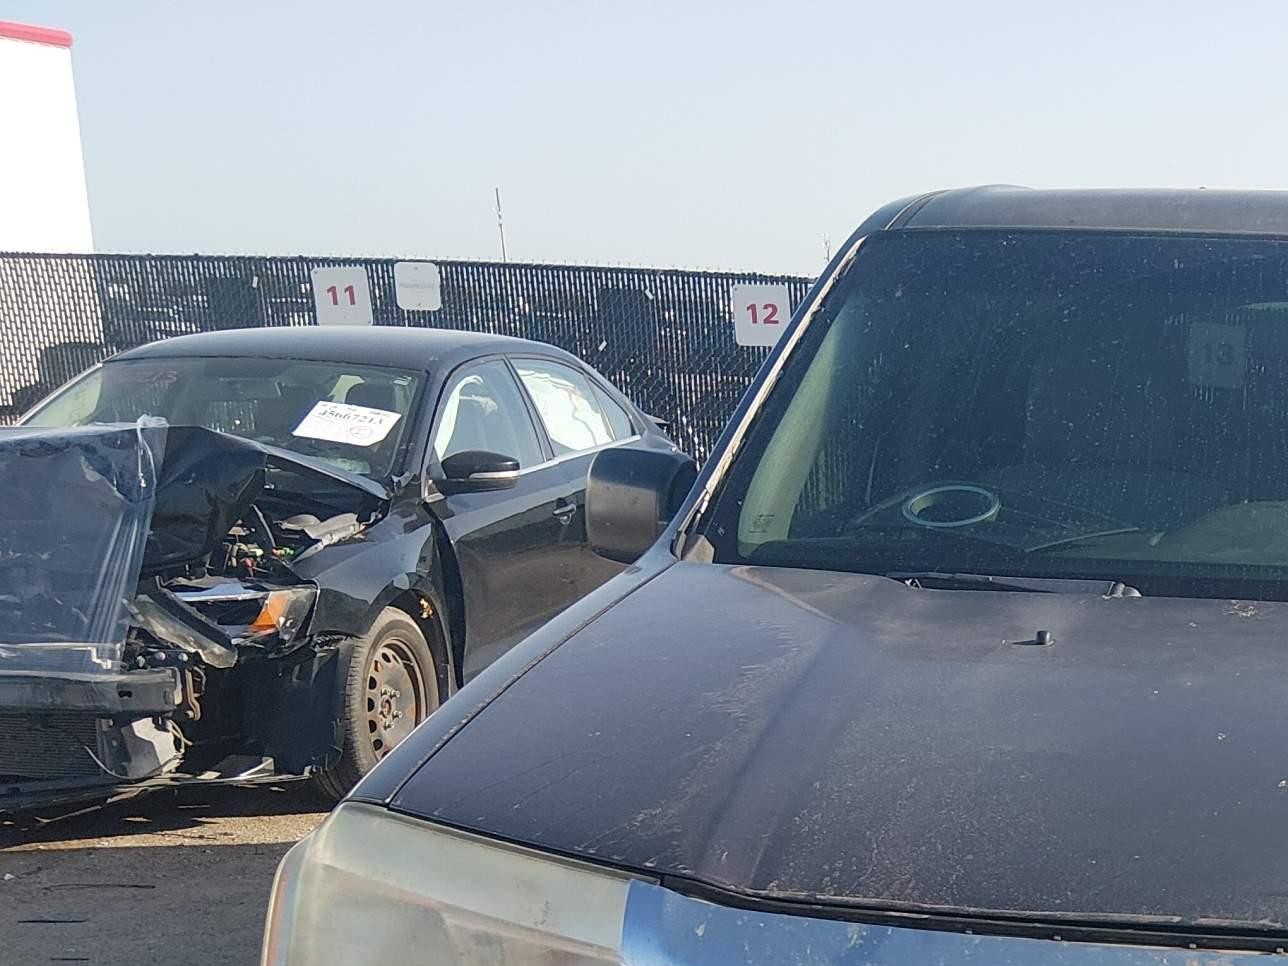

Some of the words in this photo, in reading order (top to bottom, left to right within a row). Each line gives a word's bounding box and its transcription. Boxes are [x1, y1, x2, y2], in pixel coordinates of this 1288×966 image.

[326, 284, 356, 306] 11
[747, 303, 778, 324] 12
[1200, 342, 1233, 367] 13
